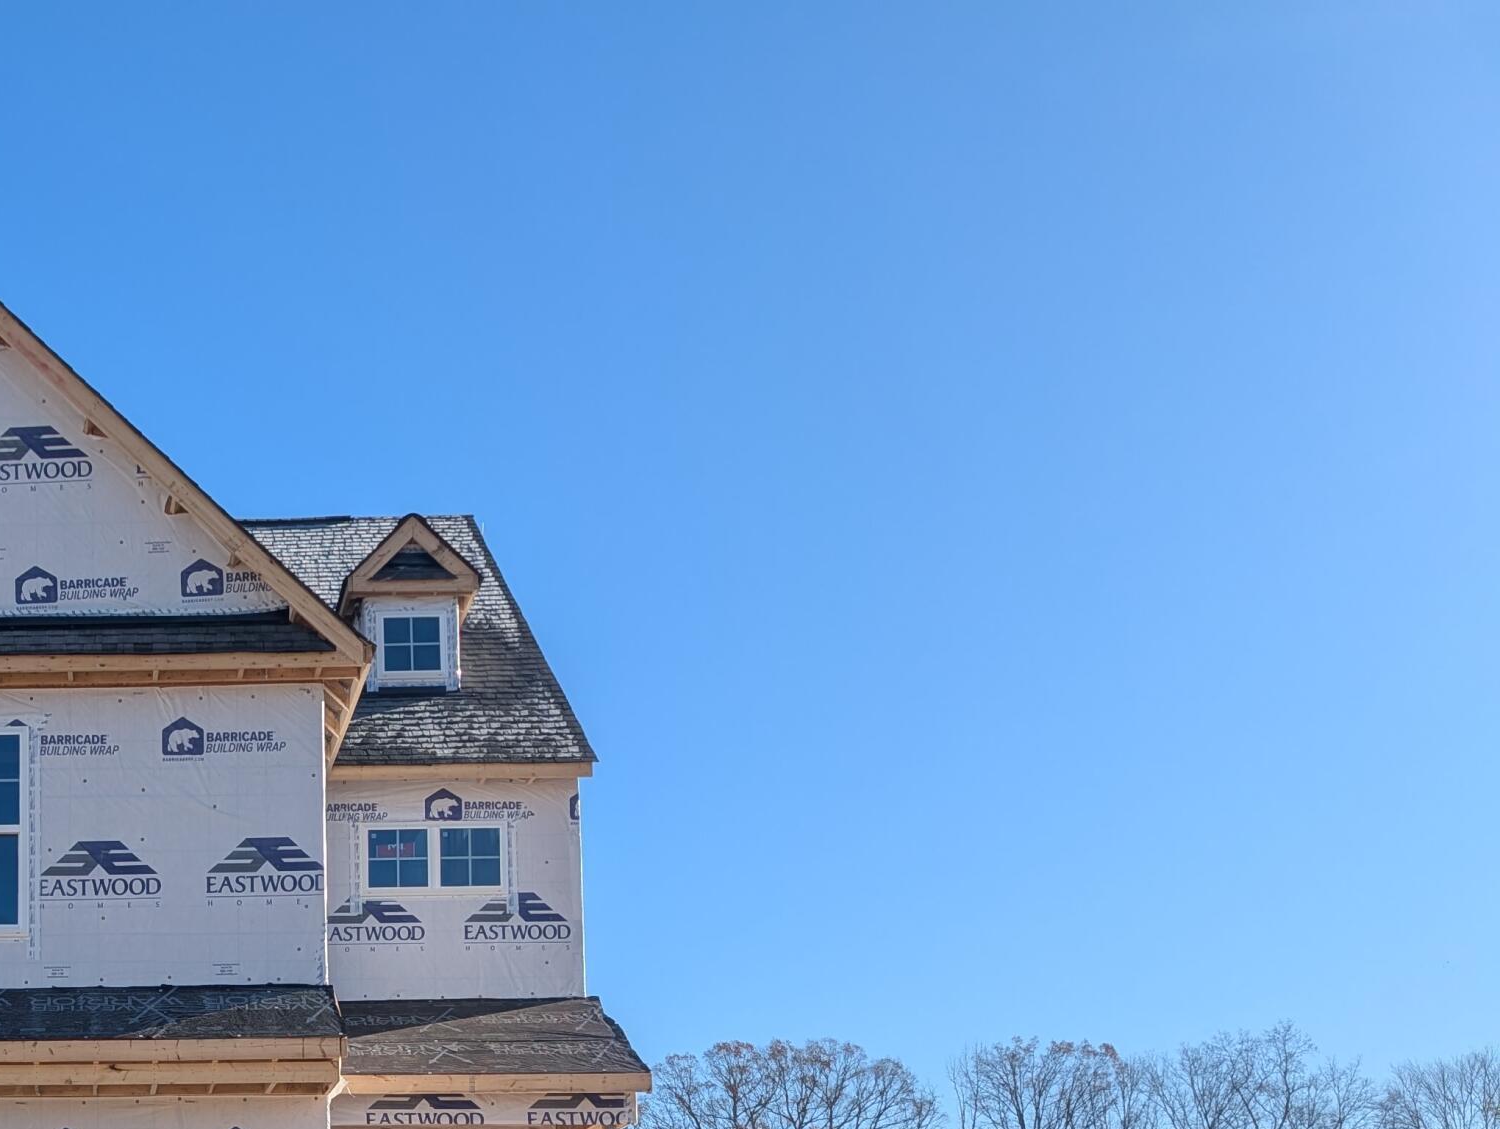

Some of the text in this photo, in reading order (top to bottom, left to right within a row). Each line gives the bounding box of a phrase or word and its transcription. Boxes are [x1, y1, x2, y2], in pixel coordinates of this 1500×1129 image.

[60, 577, 128, 589] BARRICADE
[59, 587, 139, 600] BUILDING WRAP
[40, 734, 108, 745] BARRICADE
[206, 731, 275, 742] BARRICADE
[39, 744, 120, 756] BUILDING WRAP
[206, 740, 287, 754] BUILDING WRAP
[464, 801, 522, 811] BARRICADE
[362, 811, 388, 822] WRAP
[463, 809, 511, 820] BUILDING
[40, 877, 162, 897] EASTWOOD
[464, 923, 572, 941] EASTWOOD
